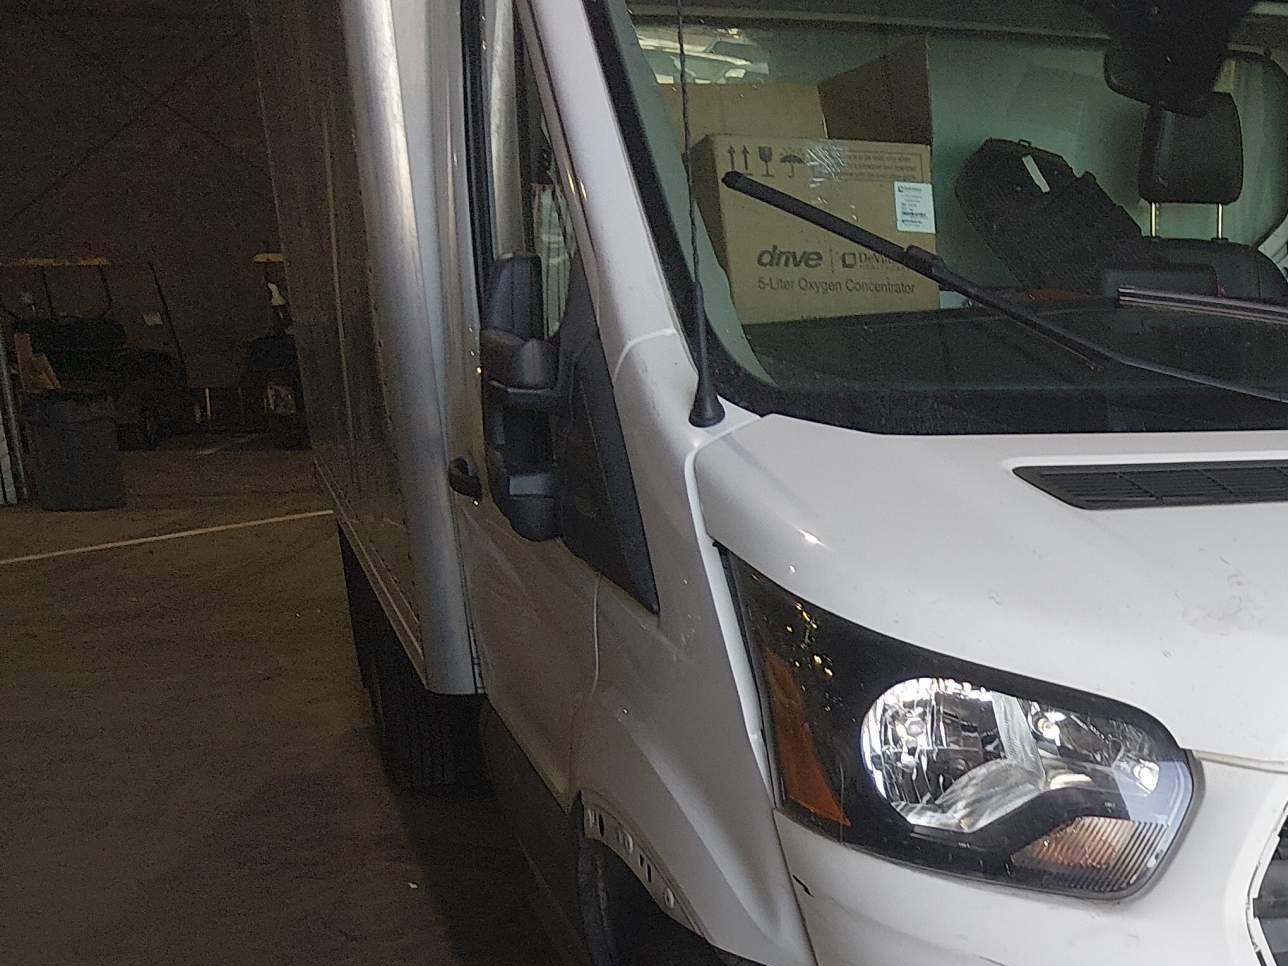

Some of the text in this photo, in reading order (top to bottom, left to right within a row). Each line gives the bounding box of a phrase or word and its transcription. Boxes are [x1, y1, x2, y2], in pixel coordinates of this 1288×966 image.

[757, 244, 823, 269] drive
[757, 277, 915, 296] 5-Liter Oxygen Concentrator
